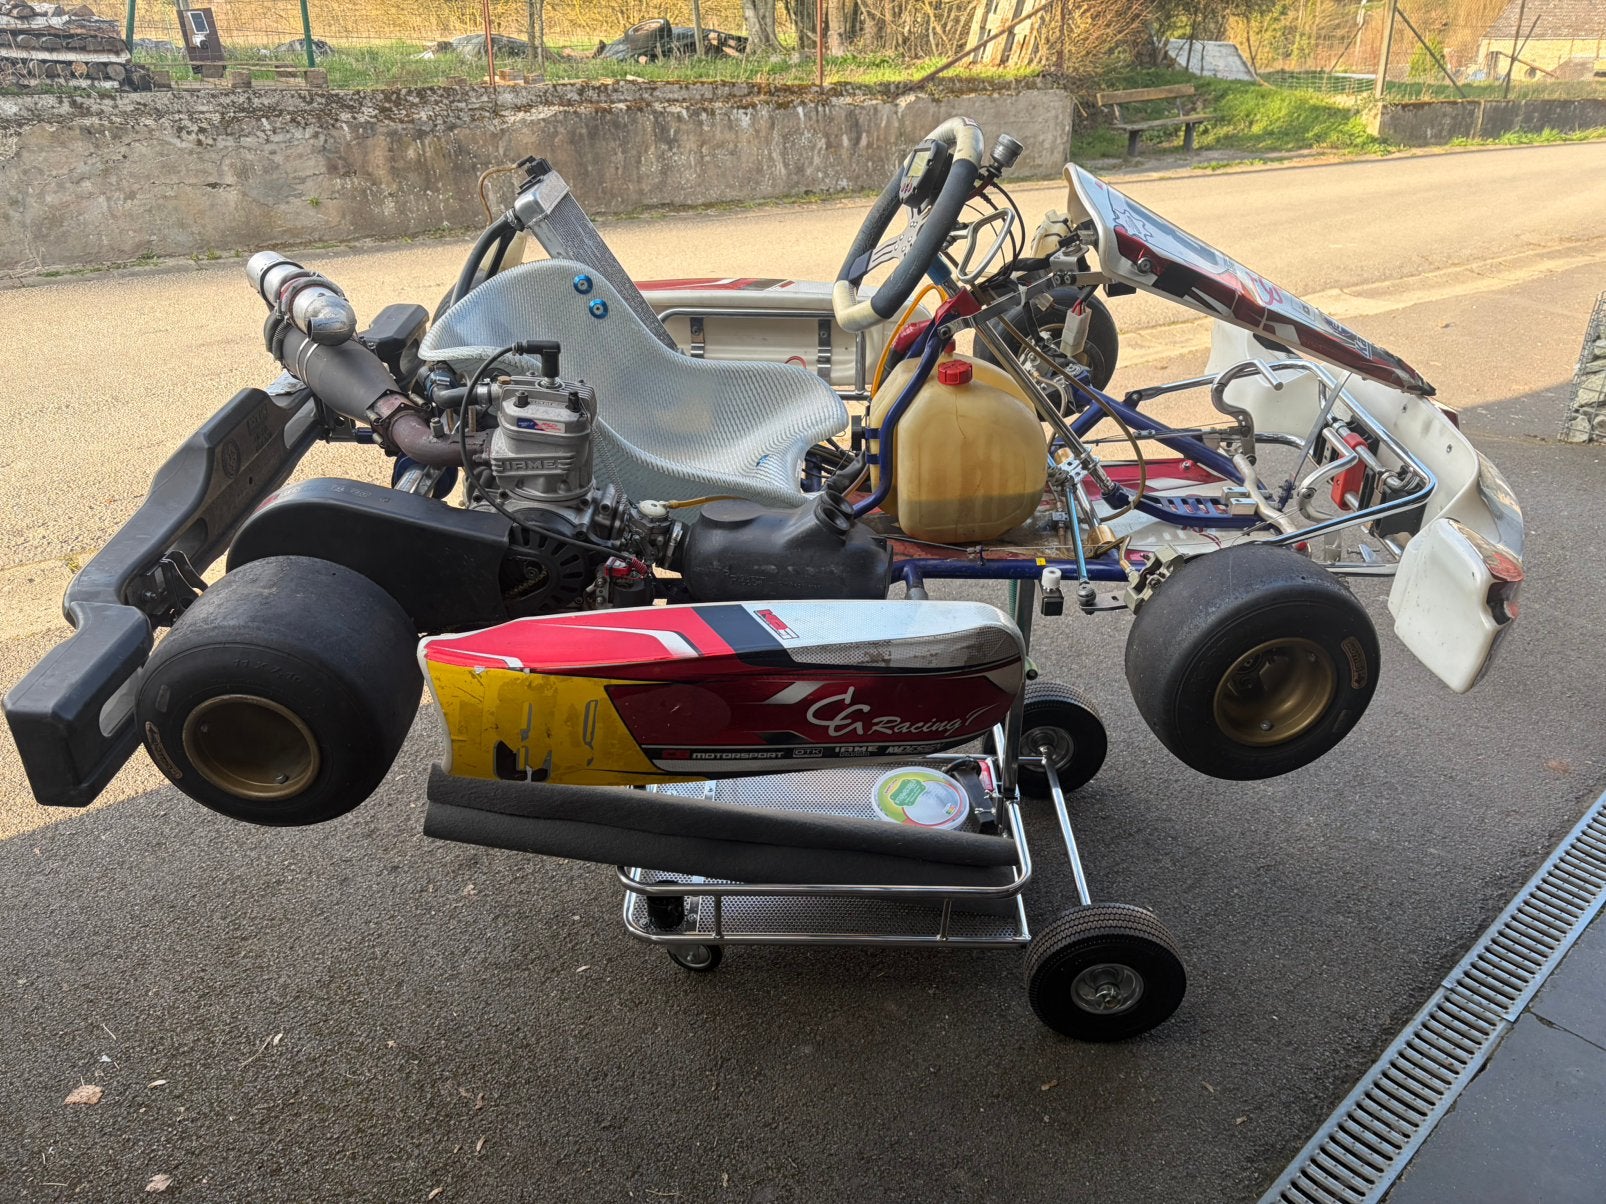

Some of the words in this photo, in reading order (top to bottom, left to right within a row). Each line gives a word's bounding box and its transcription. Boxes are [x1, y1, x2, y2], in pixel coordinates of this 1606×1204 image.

[505, 459, 556, 471] IAME
[867, 716, 963, 737] Racing
[692, 751, 784, 759] MOTORSPORT
[794, 748, 822, 757] OTK
